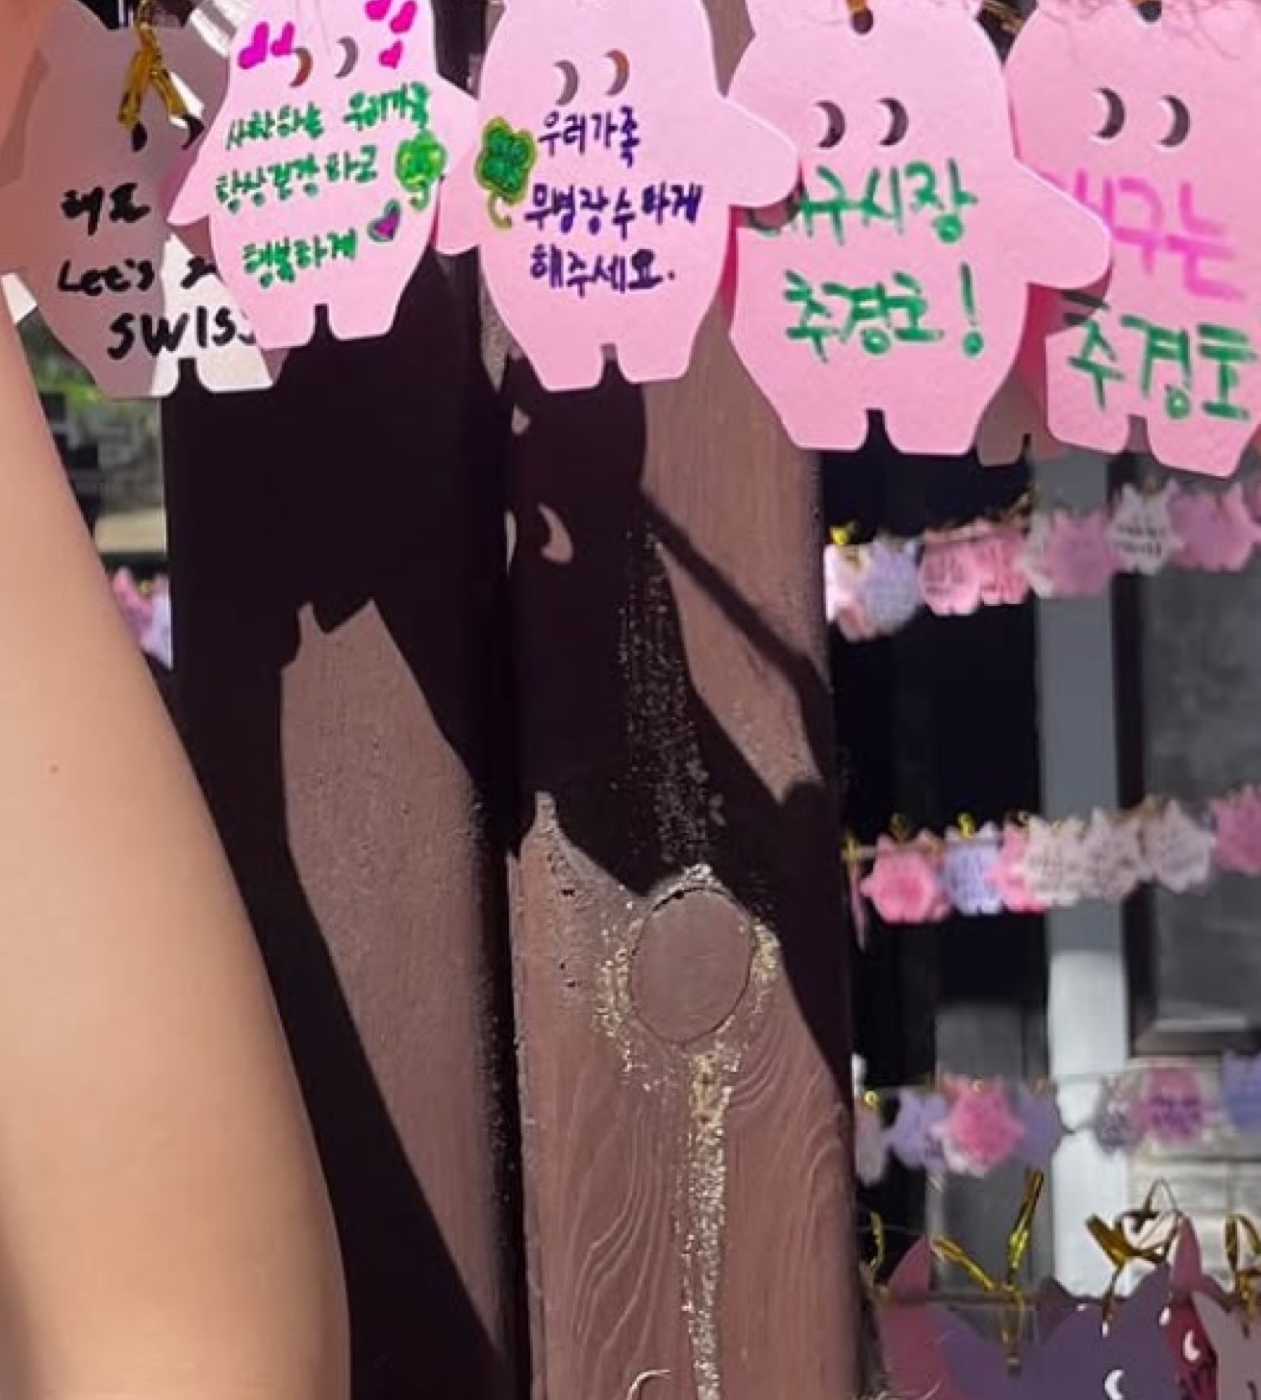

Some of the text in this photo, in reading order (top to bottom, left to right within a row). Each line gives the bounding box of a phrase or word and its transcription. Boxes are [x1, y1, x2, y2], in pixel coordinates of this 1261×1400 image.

[537, 105, 641, 168] 우리가족
[746, 157, 979, 246] 구시장
[530, 243, 676, 298] 해주세요.
[105, 304, 257, 361] SWIS
